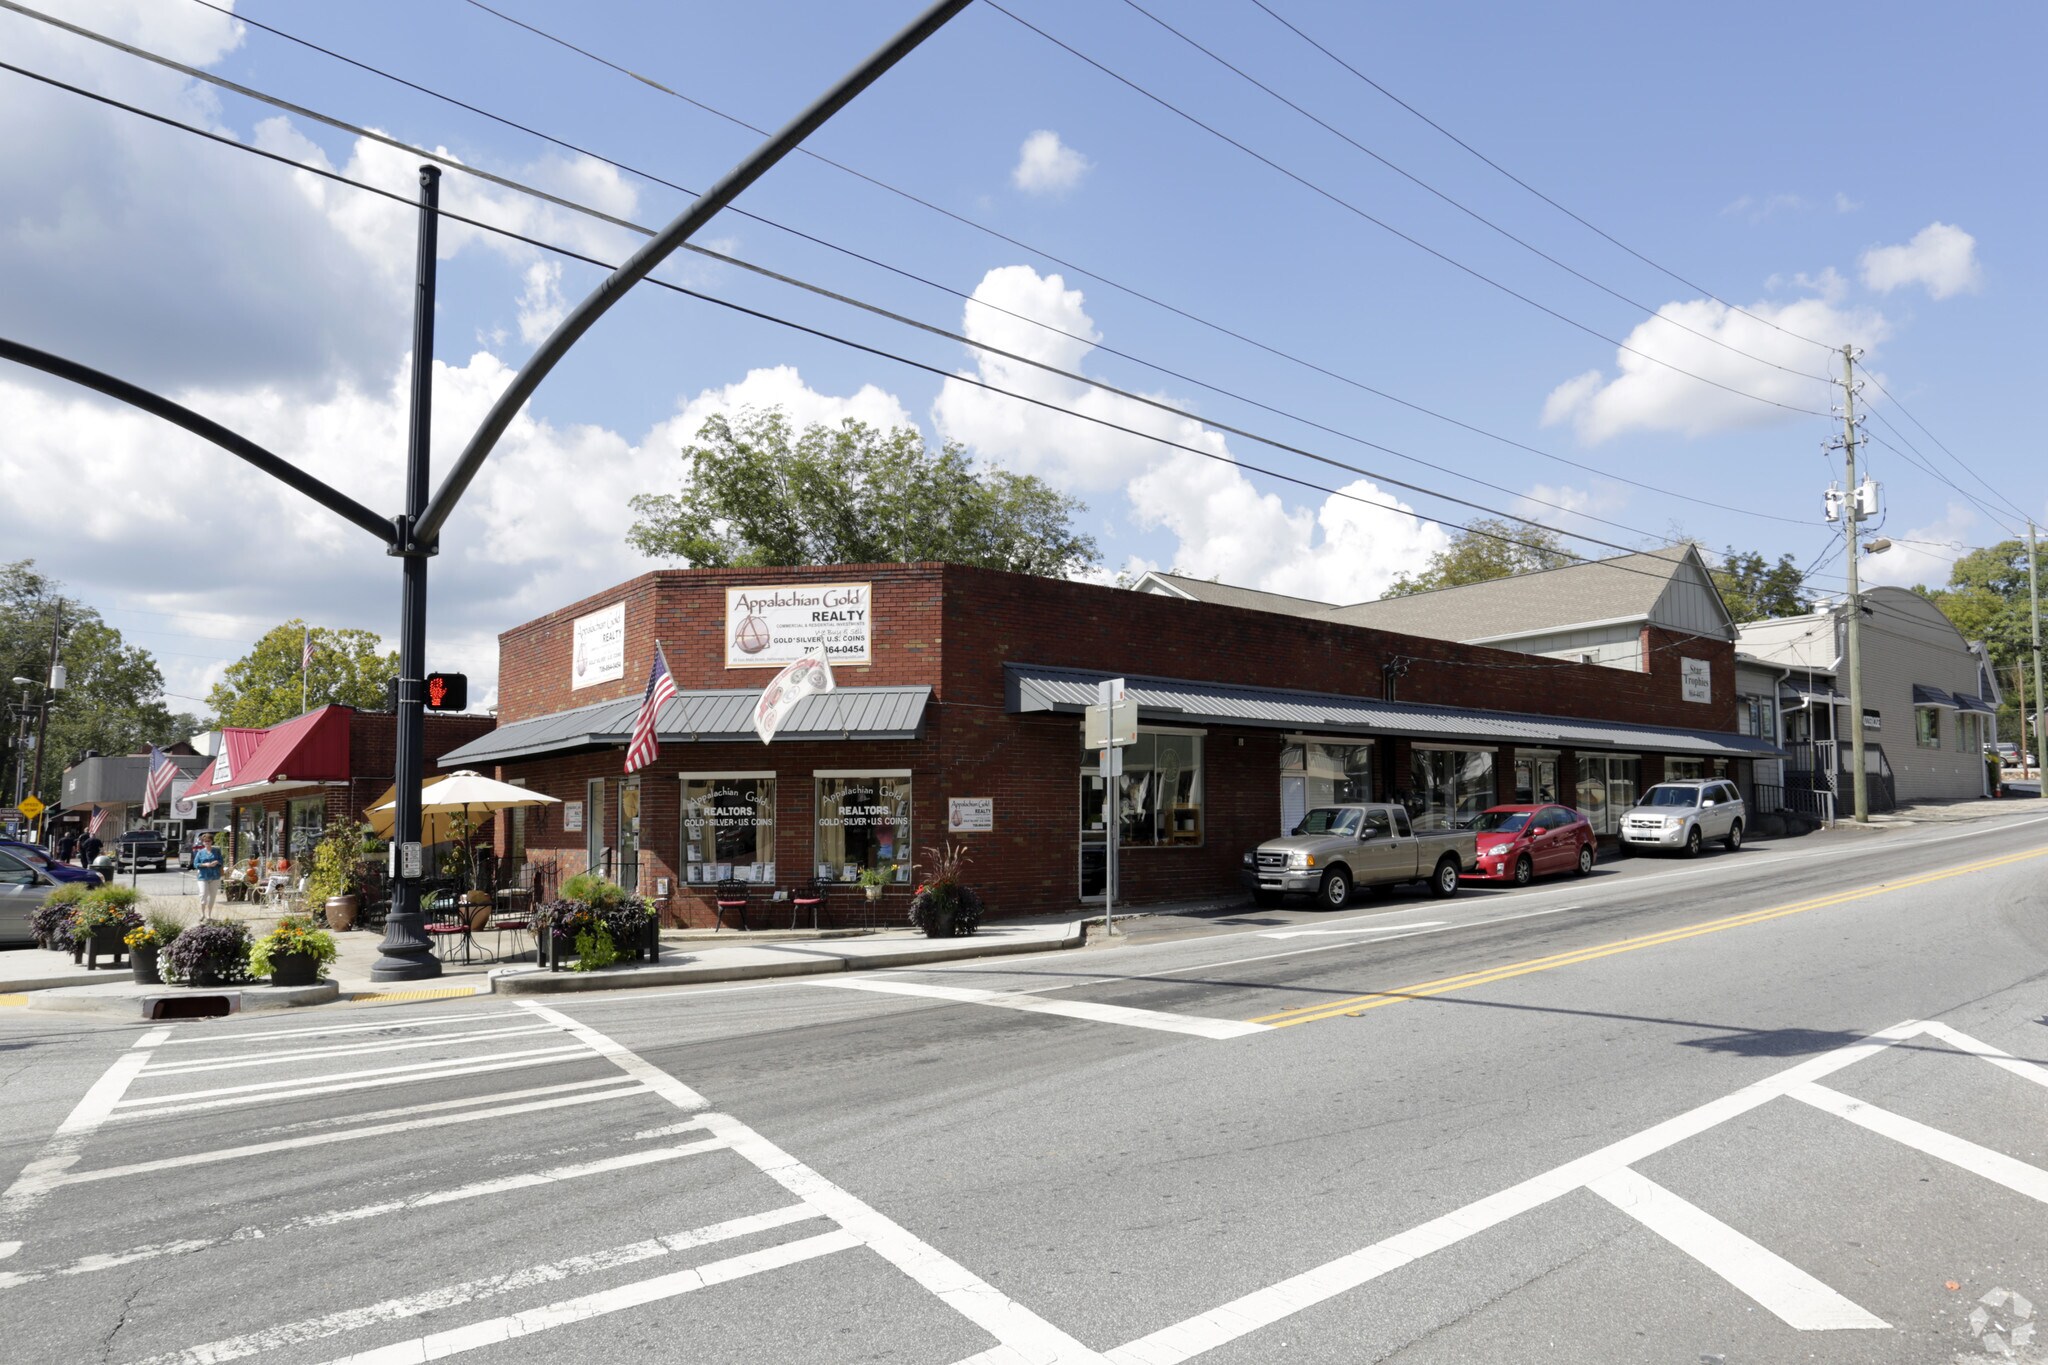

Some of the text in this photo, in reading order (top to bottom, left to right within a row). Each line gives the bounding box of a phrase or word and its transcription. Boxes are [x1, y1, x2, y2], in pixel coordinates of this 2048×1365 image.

[734, 588, 860, 614] Appalachian Gold
[812, 610, 865, 622] REALTY
[1683, 673, 1709, 688] Trophies
[689, 785, 768, 806] Appalachian Gold
[822, 784, 904, 806] Appalachian Gold
[684, 818, 705, 827] GOLD
[709, 818, 734, 827] SILVER
[750, 818, 773, 826] COINS
[818, 818, 840, 826] GOLD
[843, 817, 867, 826] SILVER
[884, 816, 908, 826] COINS
